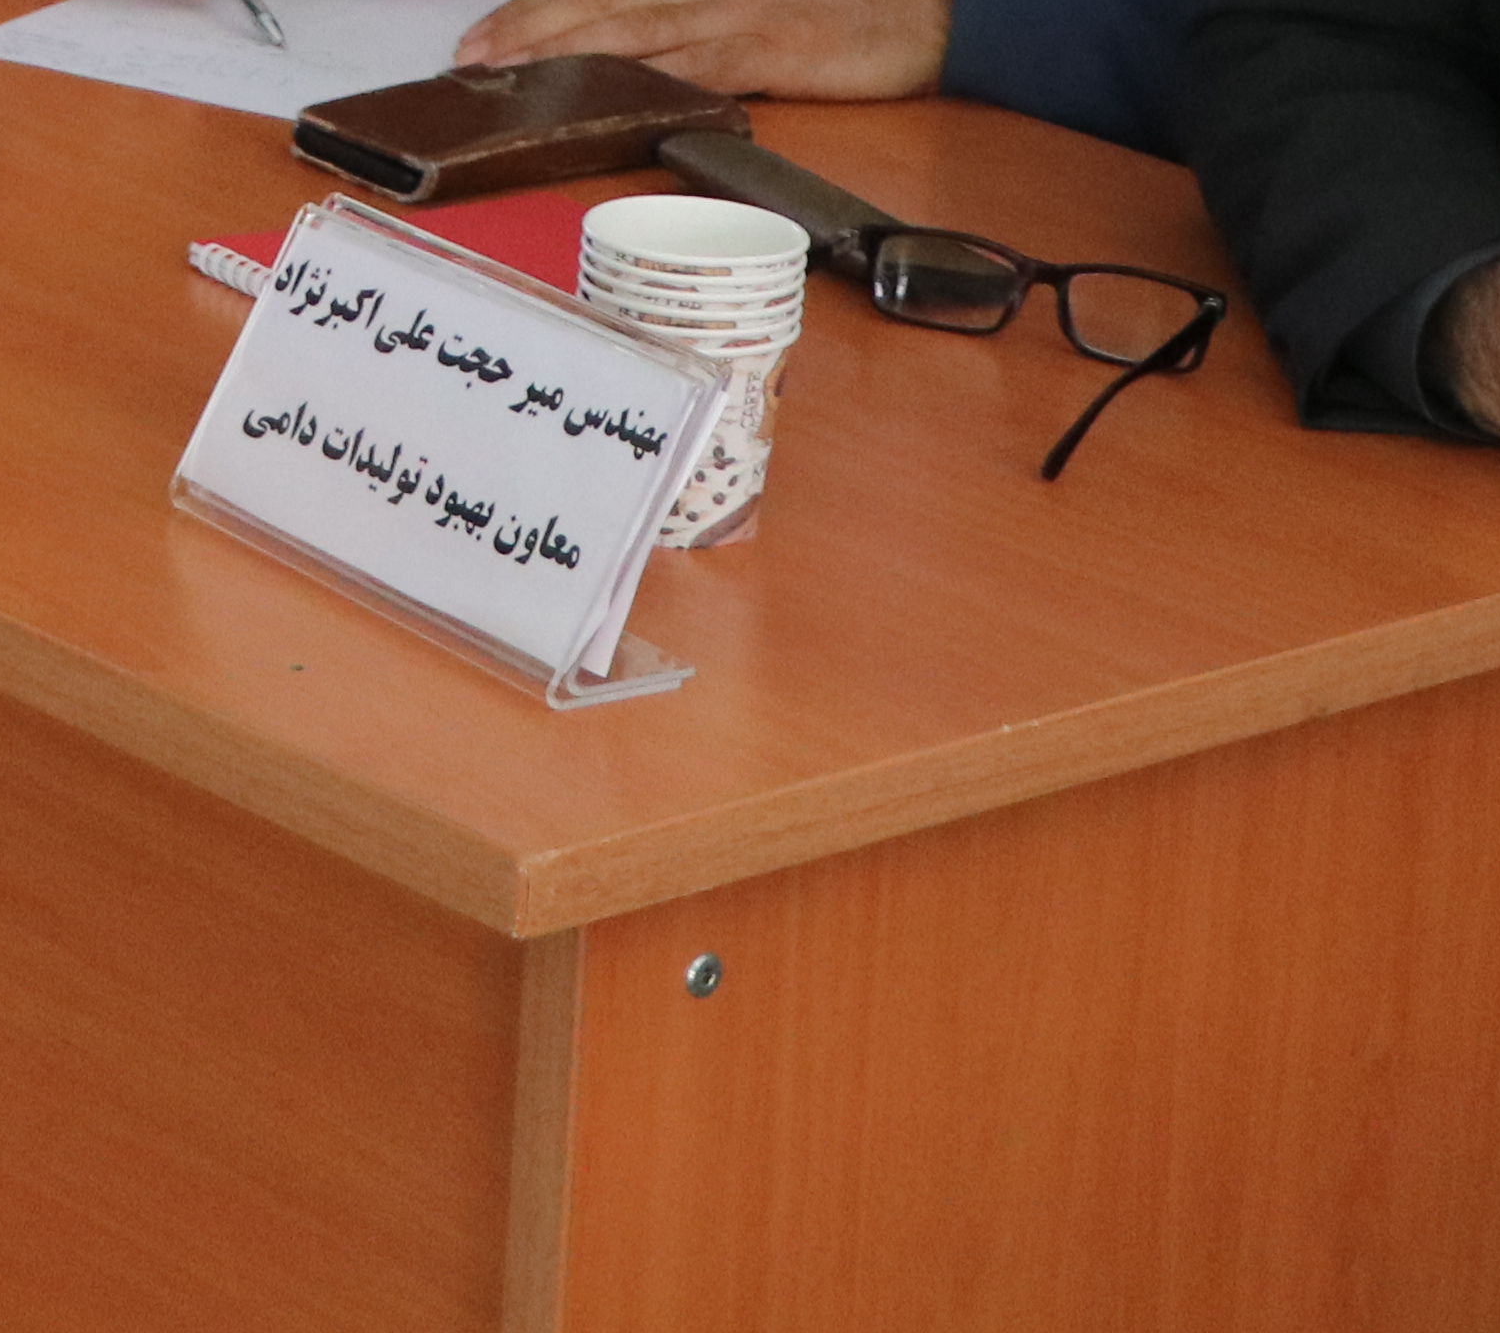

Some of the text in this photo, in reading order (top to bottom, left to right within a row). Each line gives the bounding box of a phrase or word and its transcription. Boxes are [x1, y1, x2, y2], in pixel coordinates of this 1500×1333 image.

[274, 259, 668, 460] مهندس میر حجت علی اکبرنژاد
[242, 400, 581, 570] معاون بهبود تولیدات دامی
